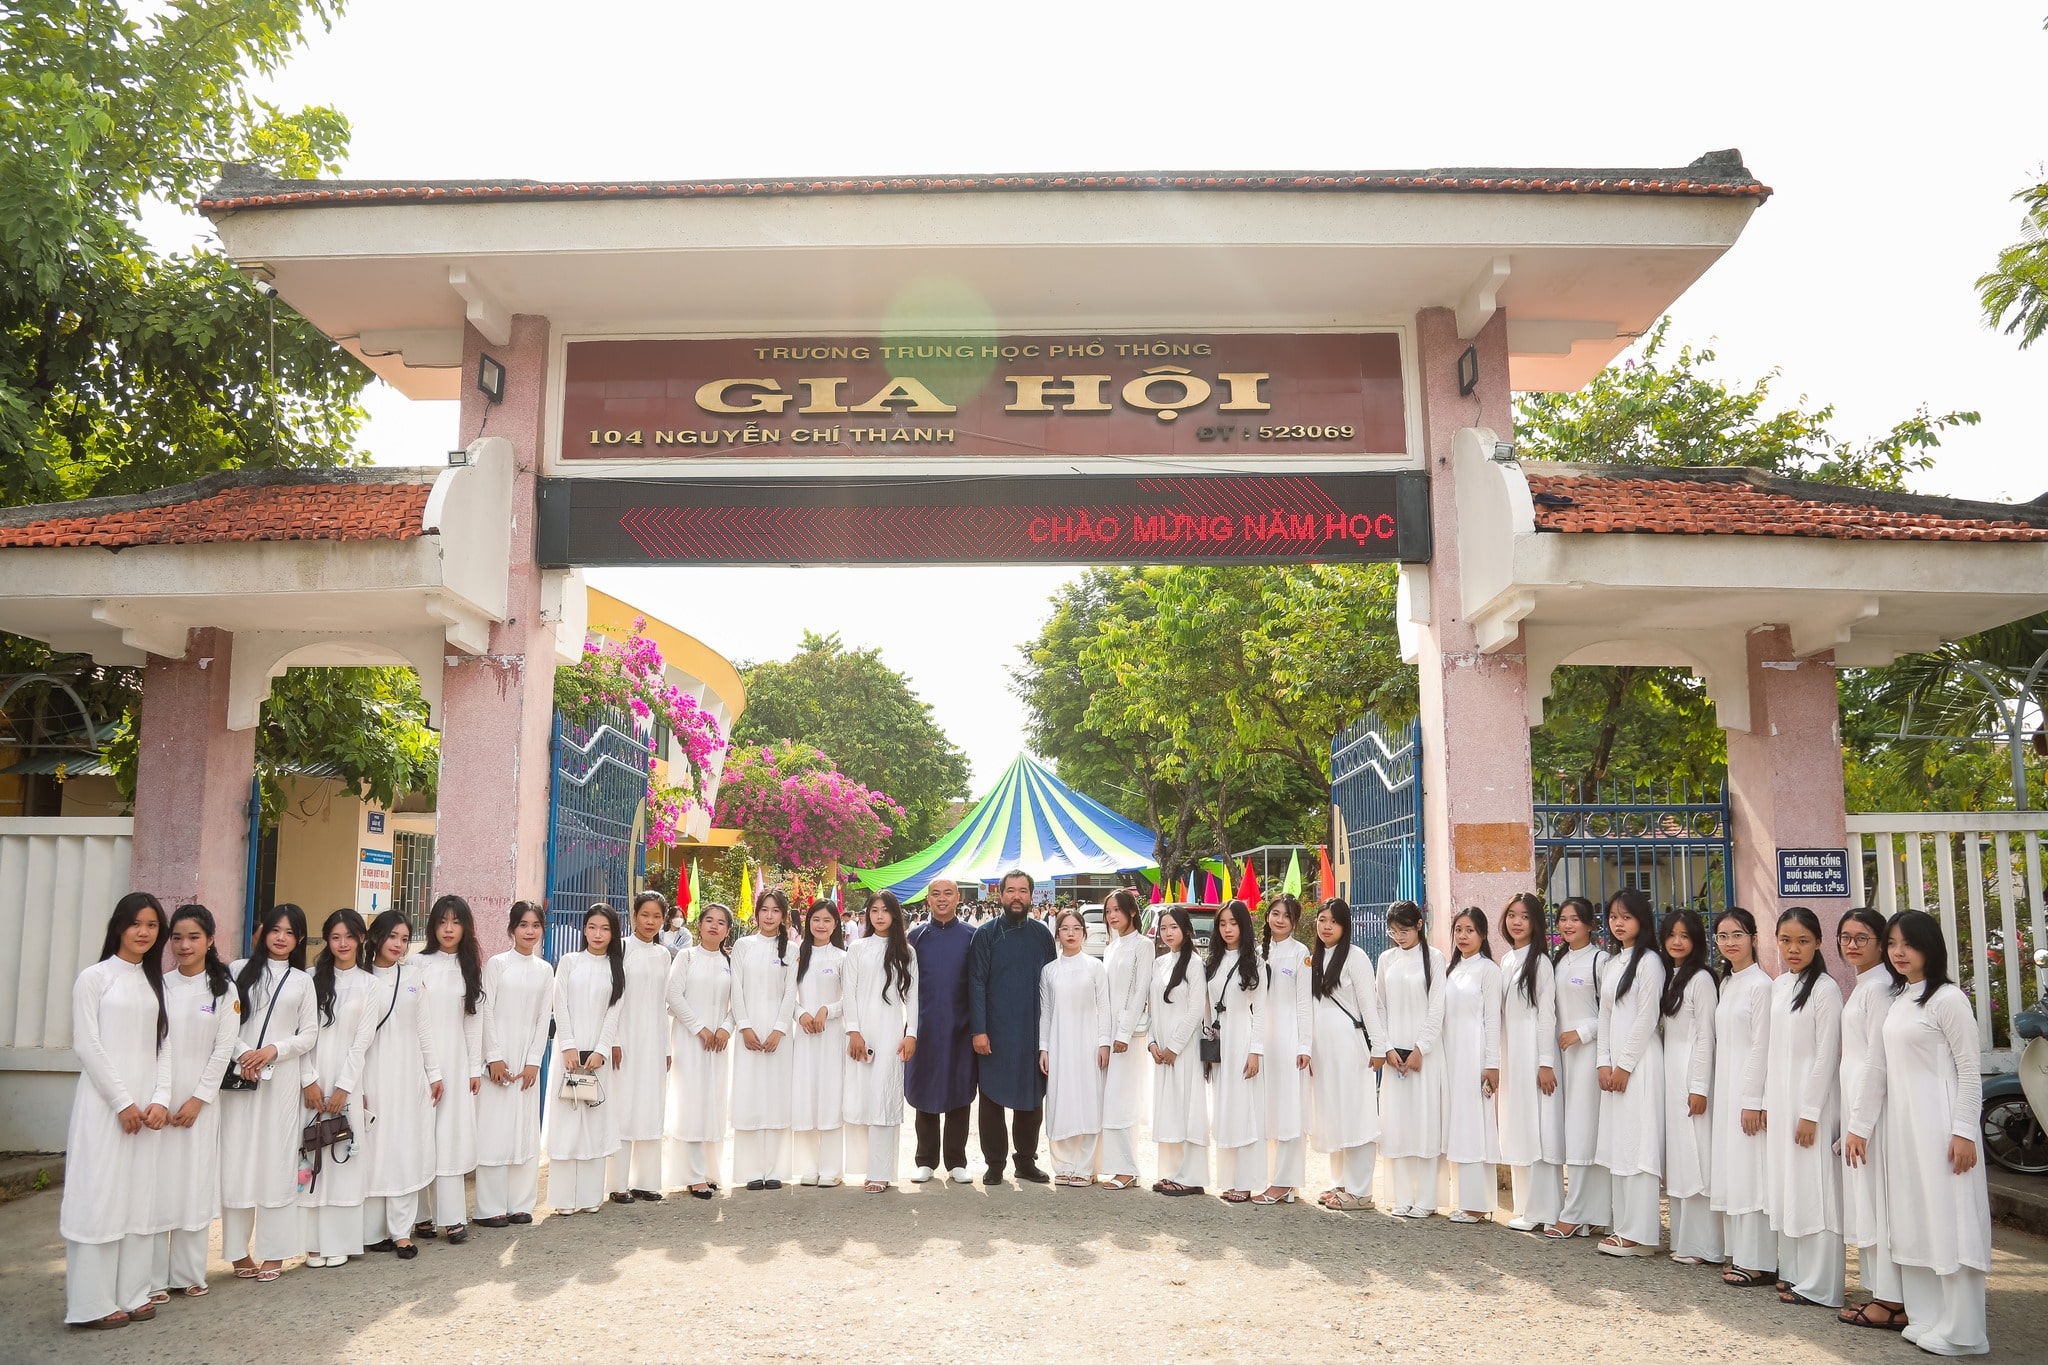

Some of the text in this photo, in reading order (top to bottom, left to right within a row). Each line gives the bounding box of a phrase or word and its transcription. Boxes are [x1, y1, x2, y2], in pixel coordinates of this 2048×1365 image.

[879, 345, 974, 359] TRUNG
[981, 345, 1040, 362] HỌC
[1049, 337, 1105, 357] PHỔ
[1114, 340, 1212, 356] THÔNG
[694, 364, 1272, 422] GIA HỘI
[589, 429, 643, 444] 104
[655, 420, 780, 444] NGUYỄN
[790, 424, 840, 442] CHÍ
[1259, 425, 1356, 439] 523069
[1028, 508, 1395, 546] CHÀO MỪNG NĂM HỌC
[1784, 855, 1797, 866] GIỜ
[1798, 855, 1819, 866] ĐÓNG
[1803, 870, 1824, 879] SÁNG:
